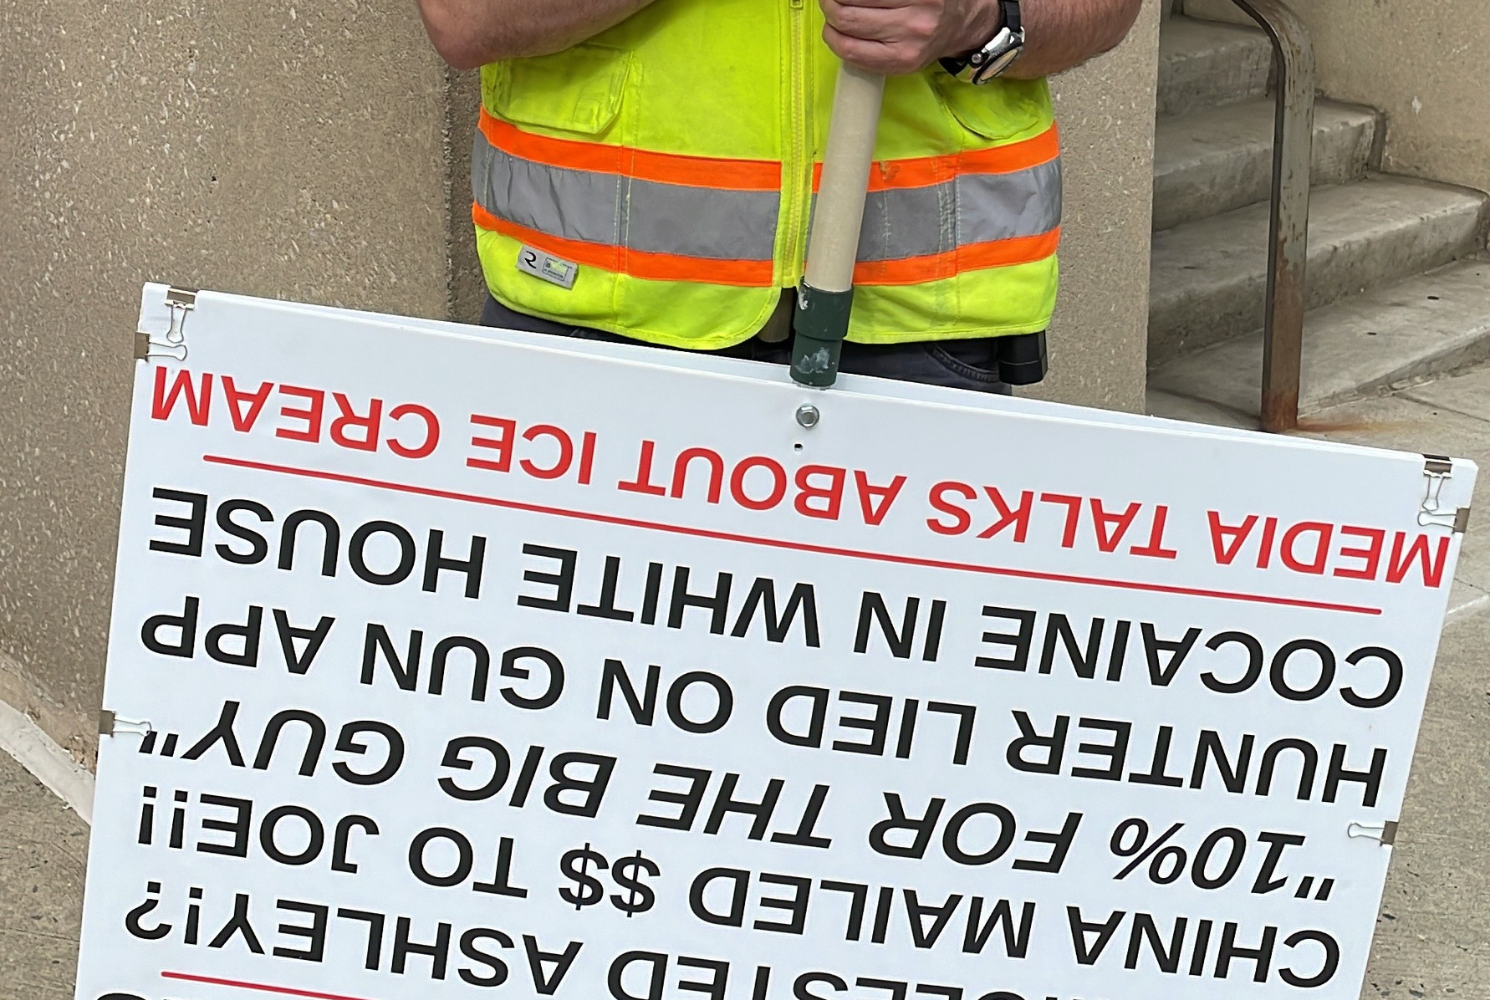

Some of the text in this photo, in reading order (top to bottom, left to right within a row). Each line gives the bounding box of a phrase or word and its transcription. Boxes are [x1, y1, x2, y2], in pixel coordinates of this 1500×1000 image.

[151, 365, 1450, 588] MEDIA TALKS ABOUT ICE CREAM
[148, 486, 1404, 709] COCAINE IN WHITE HOUSE
[140, 595, 1388, 808] HUNTER LIED ON GUN APP
[137, 786, 380, 875] JOE!!
[138, 700, 1335, 902] "10% FOR THE BIG GUY"
[408, 826, 528, 899] TO
[558, 842, 661, 918] $$
[688, 867, 1036, 959] MAILED
[125, 882, 584, 996] ASHLEY!?
[1066, 905, 1340, 989] CHINA
